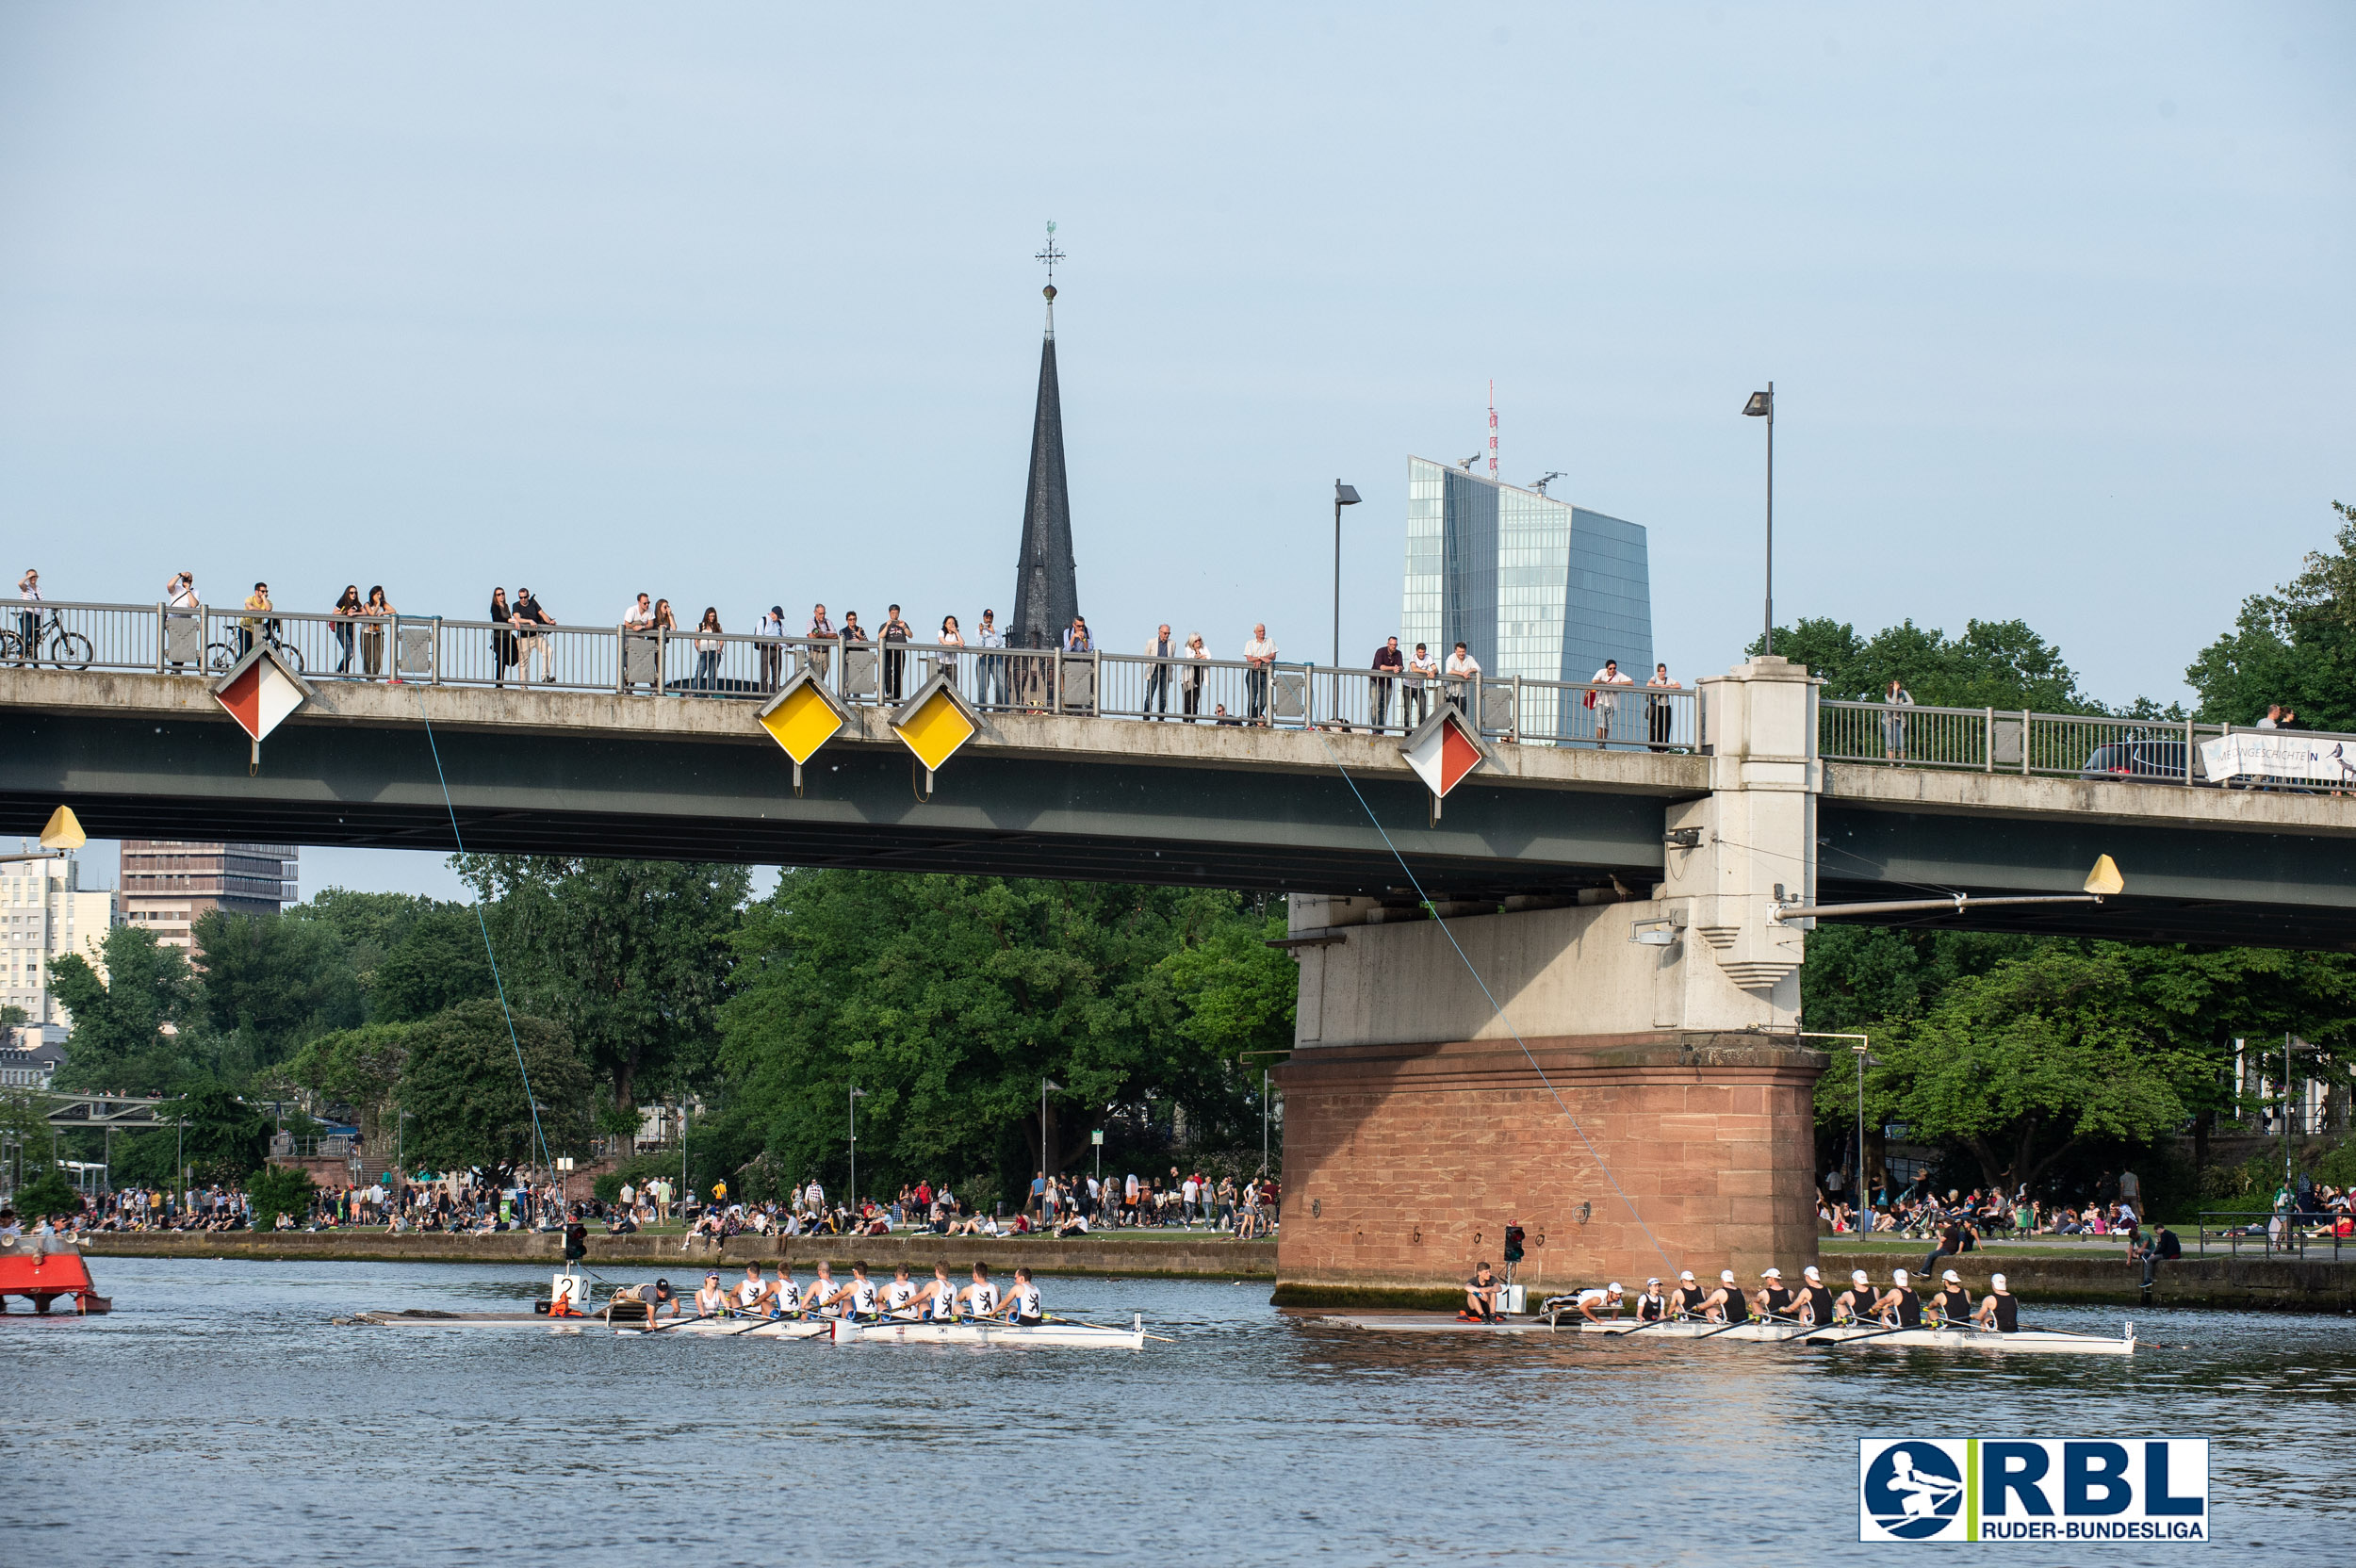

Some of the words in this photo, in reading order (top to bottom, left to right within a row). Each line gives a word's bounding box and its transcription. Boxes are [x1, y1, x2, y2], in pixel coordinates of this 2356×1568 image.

[559, 1278, 573, 1299] 2
[581, 1279, 589, 1300] 2
[1501, 1288, 1510, 1309] 1
